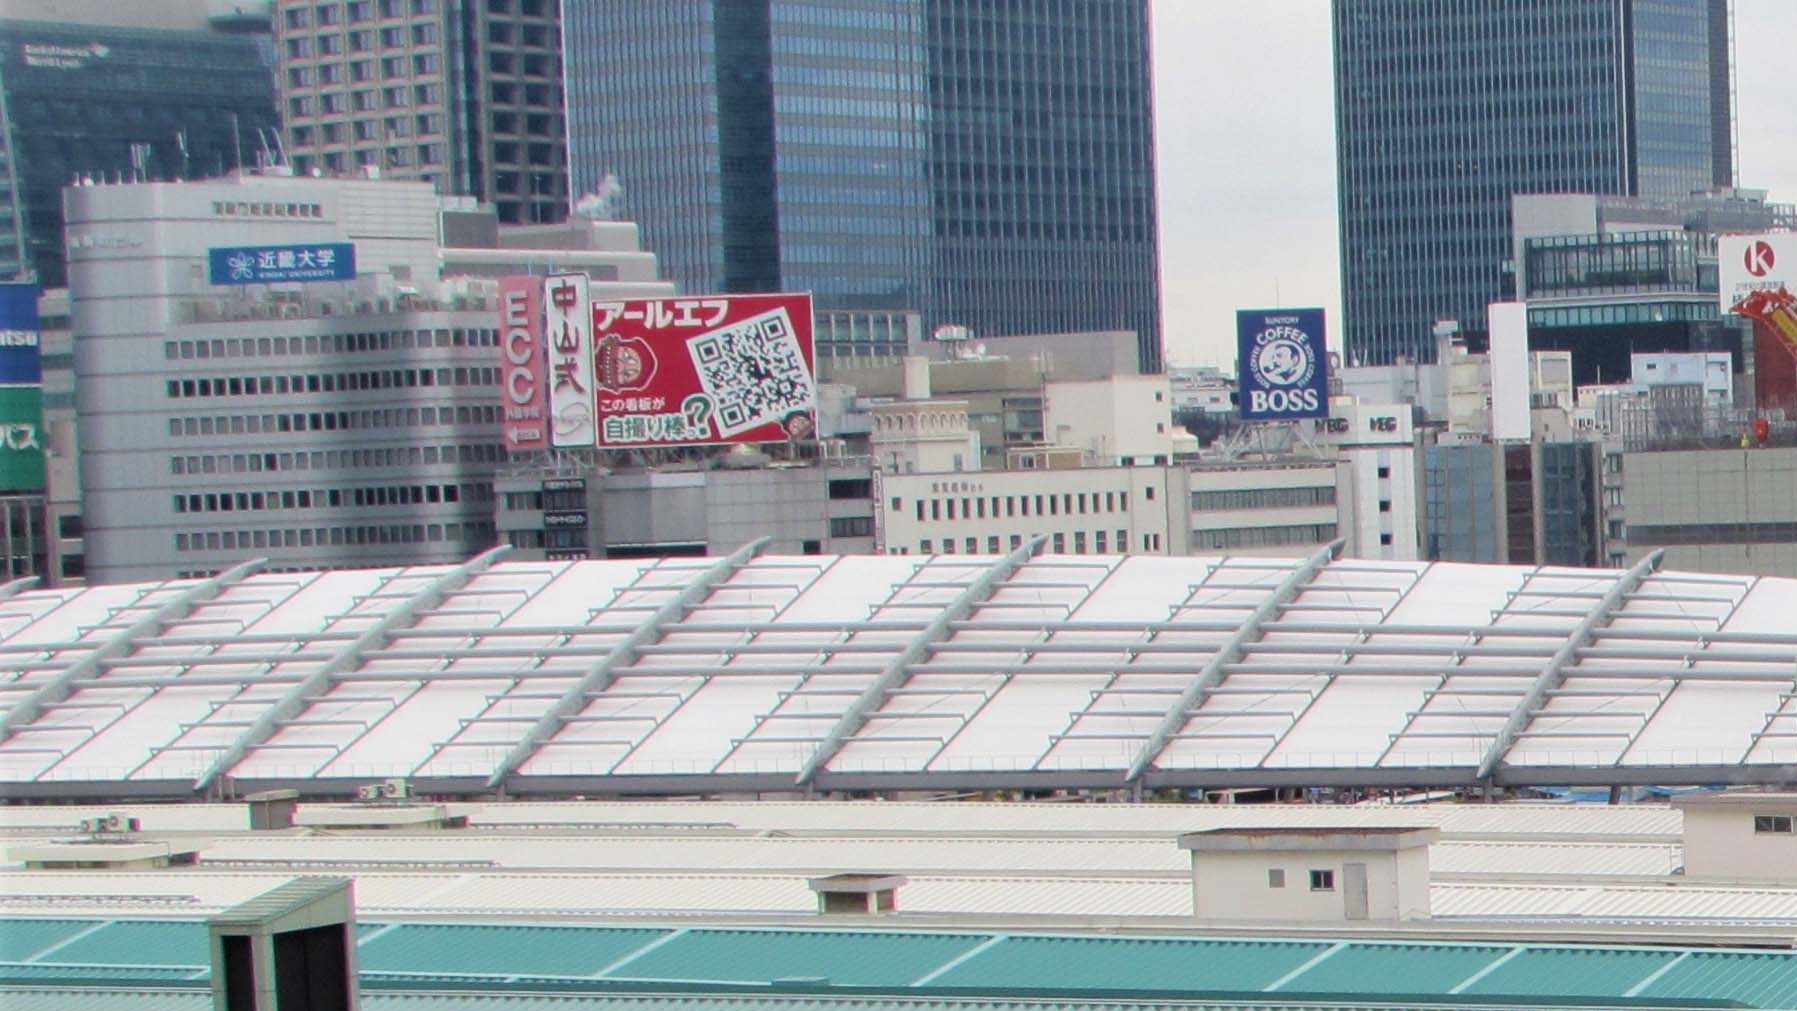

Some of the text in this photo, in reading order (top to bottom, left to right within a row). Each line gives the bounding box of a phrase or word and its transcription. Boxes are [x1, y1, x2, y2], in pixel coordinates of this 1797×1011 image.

[596, 300, 729, 331] アールエフ
[505, 290, 535, 405] ECC
[1256, 327, 1310, 346] COFFEE
[600, 397, 665, 412] この看板が
[1249, 388, 1319, 413] BOSS
